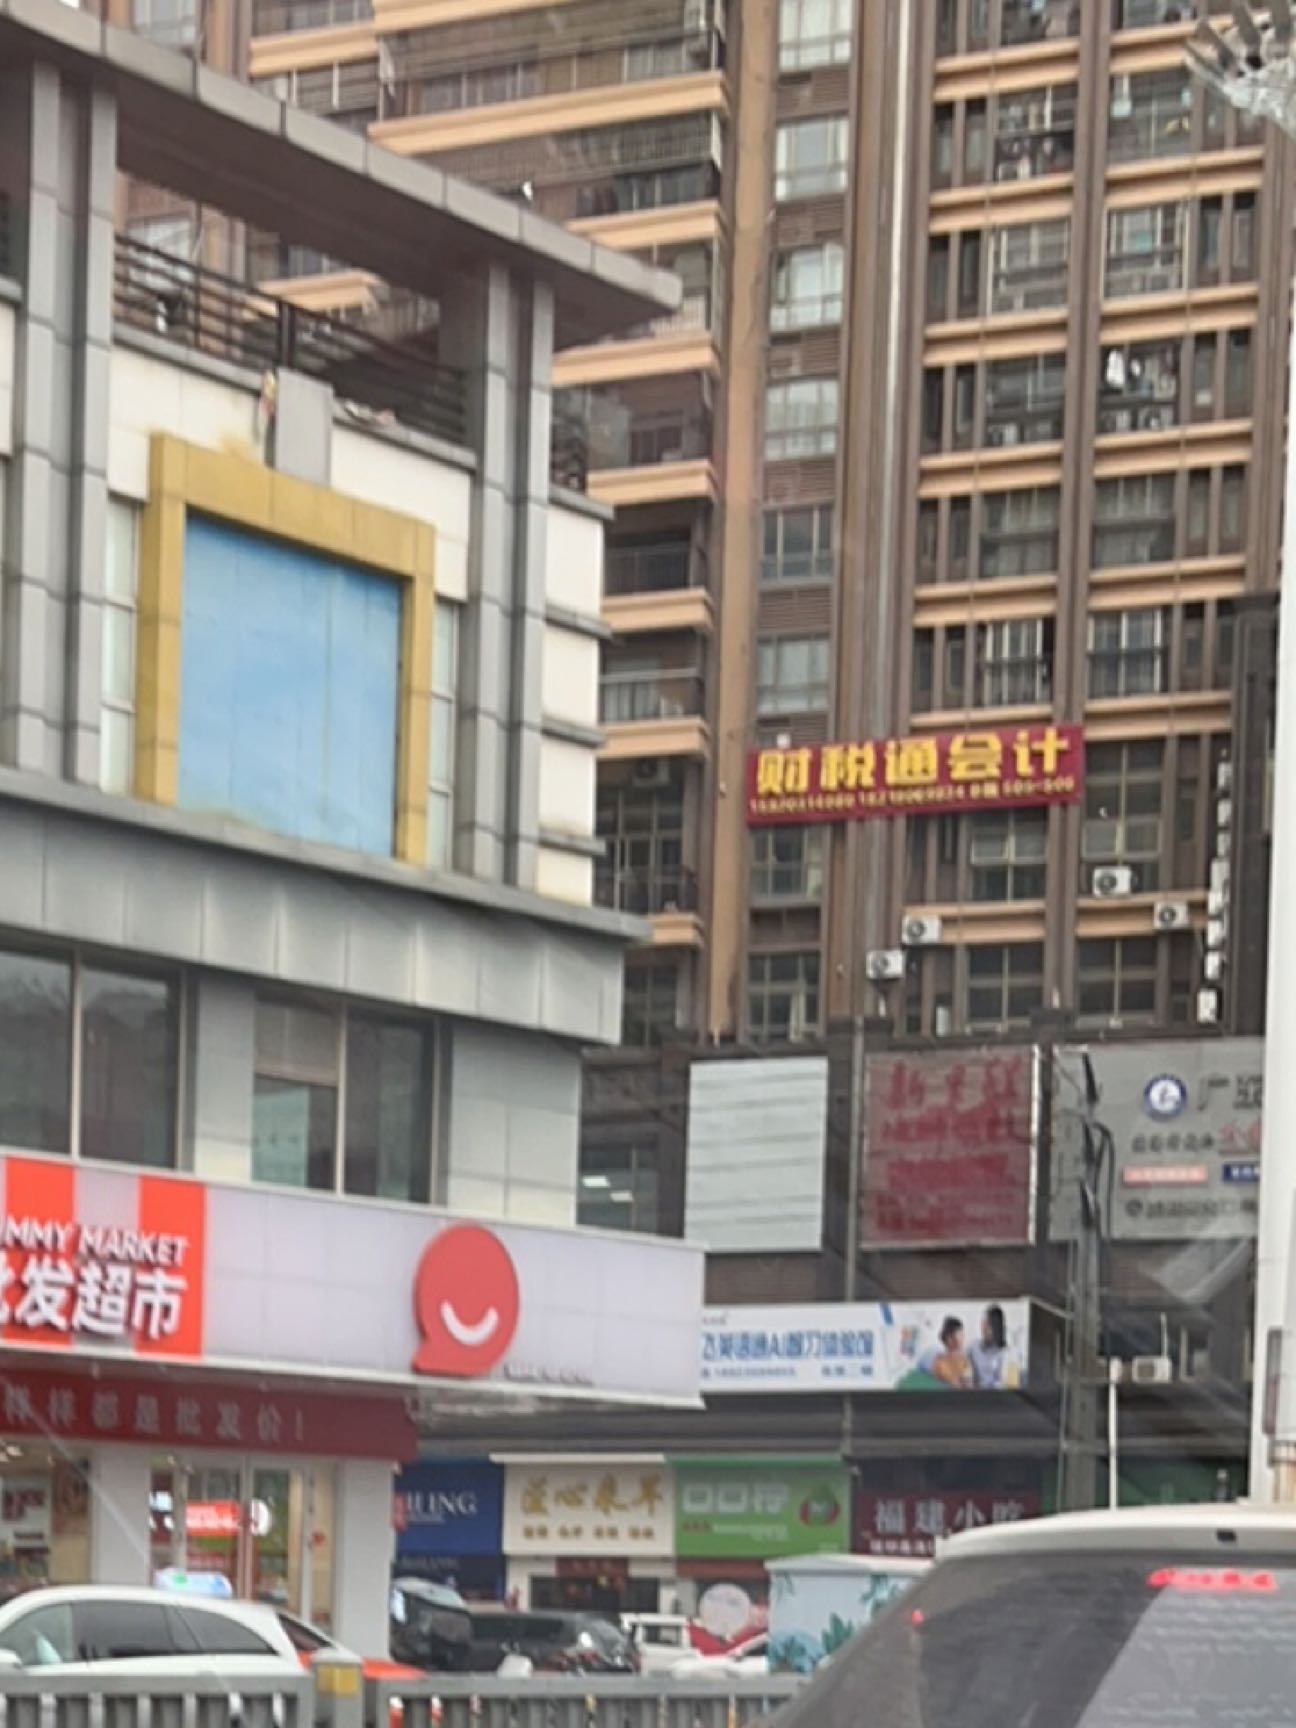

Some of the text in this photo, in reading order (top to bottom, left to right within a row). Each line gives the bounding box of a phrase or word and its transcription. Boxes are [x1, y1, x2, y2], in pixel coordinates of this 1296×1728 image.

[756, 727, 1069, 796] 财税通会计
[77, 1224, 188, 1268] MARKET
